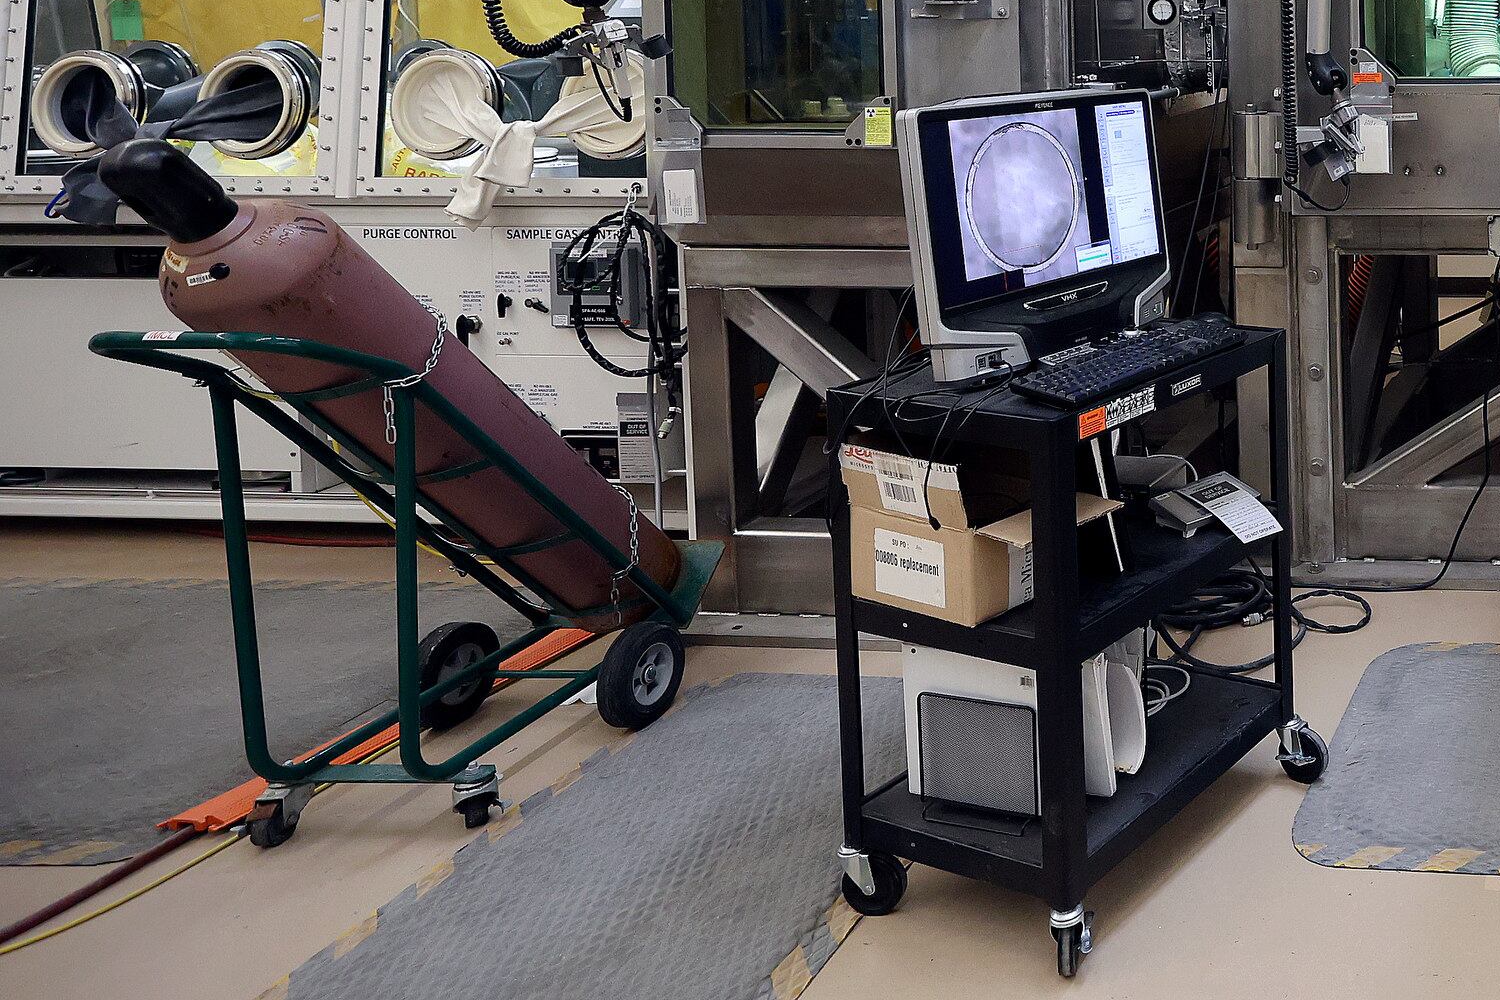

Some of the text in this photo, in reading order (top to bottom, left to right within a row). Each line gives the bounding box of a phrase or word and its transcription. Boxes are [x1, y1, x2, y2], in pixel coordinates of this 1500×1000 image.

[362, 228, 458, 240] PURGE CONTROL
[506, 228, 552, 240] SAMPLE
[556, 228, 579, 240] GAS
[1061, 292, 1079, 302] VHX
[1178, 377, 1202, 391] LUXOR
[1201, 487, 1216, 496] OUT
[899, 557, 941, 577] replacement
